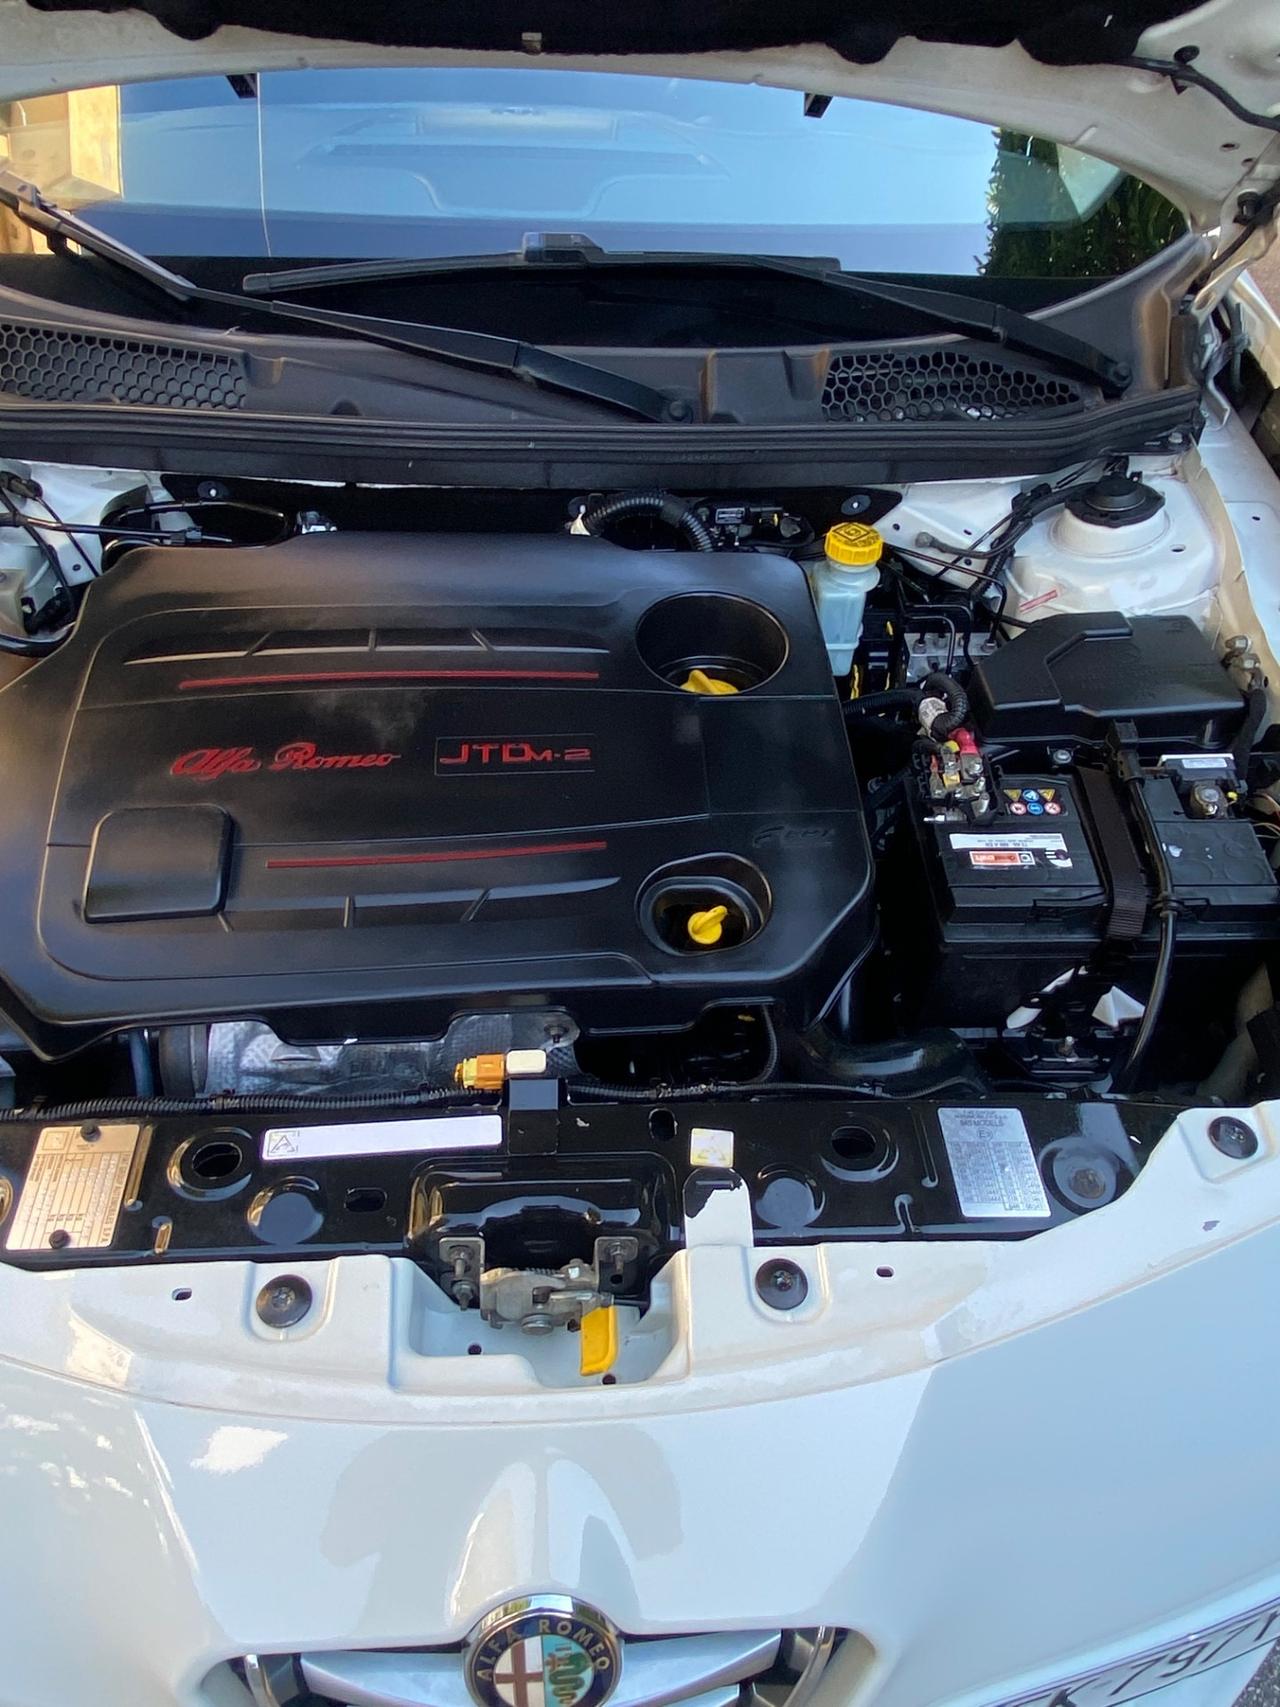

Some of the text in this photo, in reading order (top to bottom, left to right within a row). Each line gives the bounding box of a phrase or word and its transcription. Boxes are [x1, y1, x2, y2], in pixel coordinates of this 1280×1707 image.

[170, 741, 401, 782] Alfa Romeo
[477, 1619, 611, 1682] ALFA ROMEO
